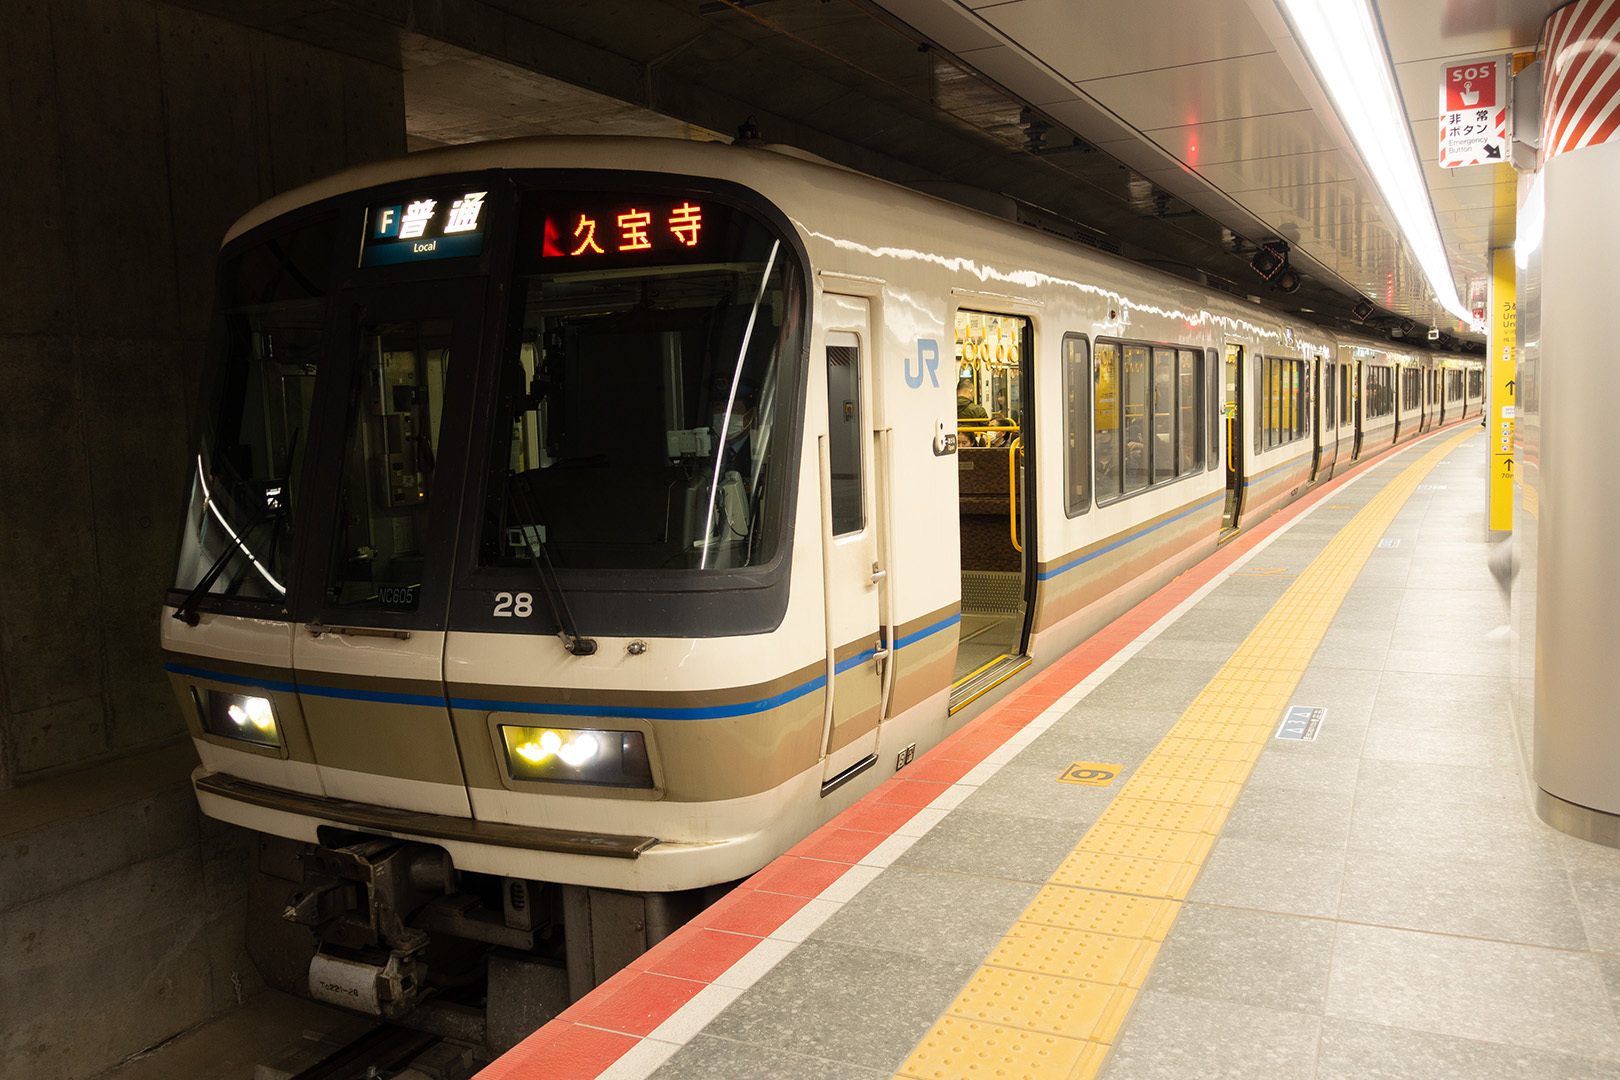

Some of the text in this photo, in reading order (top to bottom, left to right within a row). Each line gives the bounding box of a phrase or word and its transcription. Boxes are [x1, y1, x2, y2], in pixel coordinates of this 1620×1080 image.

[1452, 66, 1490, 82] SOS
[1449, 110, 1488, 125] 非常
[1449, 124, 1488, 137] ボタン
[1448, 137, 1489, 147] Emergency
[1448, 146, 1473, 154] Button
[381, 191, 488, 239] F 普通
[570, 202, 702, 256] 久宝寺
[413, 241, 436, 253] Local
[904, 338, 940, 389] JR
[378, 588, 413, 604] NC605
[493, 592, 533, 618] 28
[320, 981, 359, 996] Tc221-28
